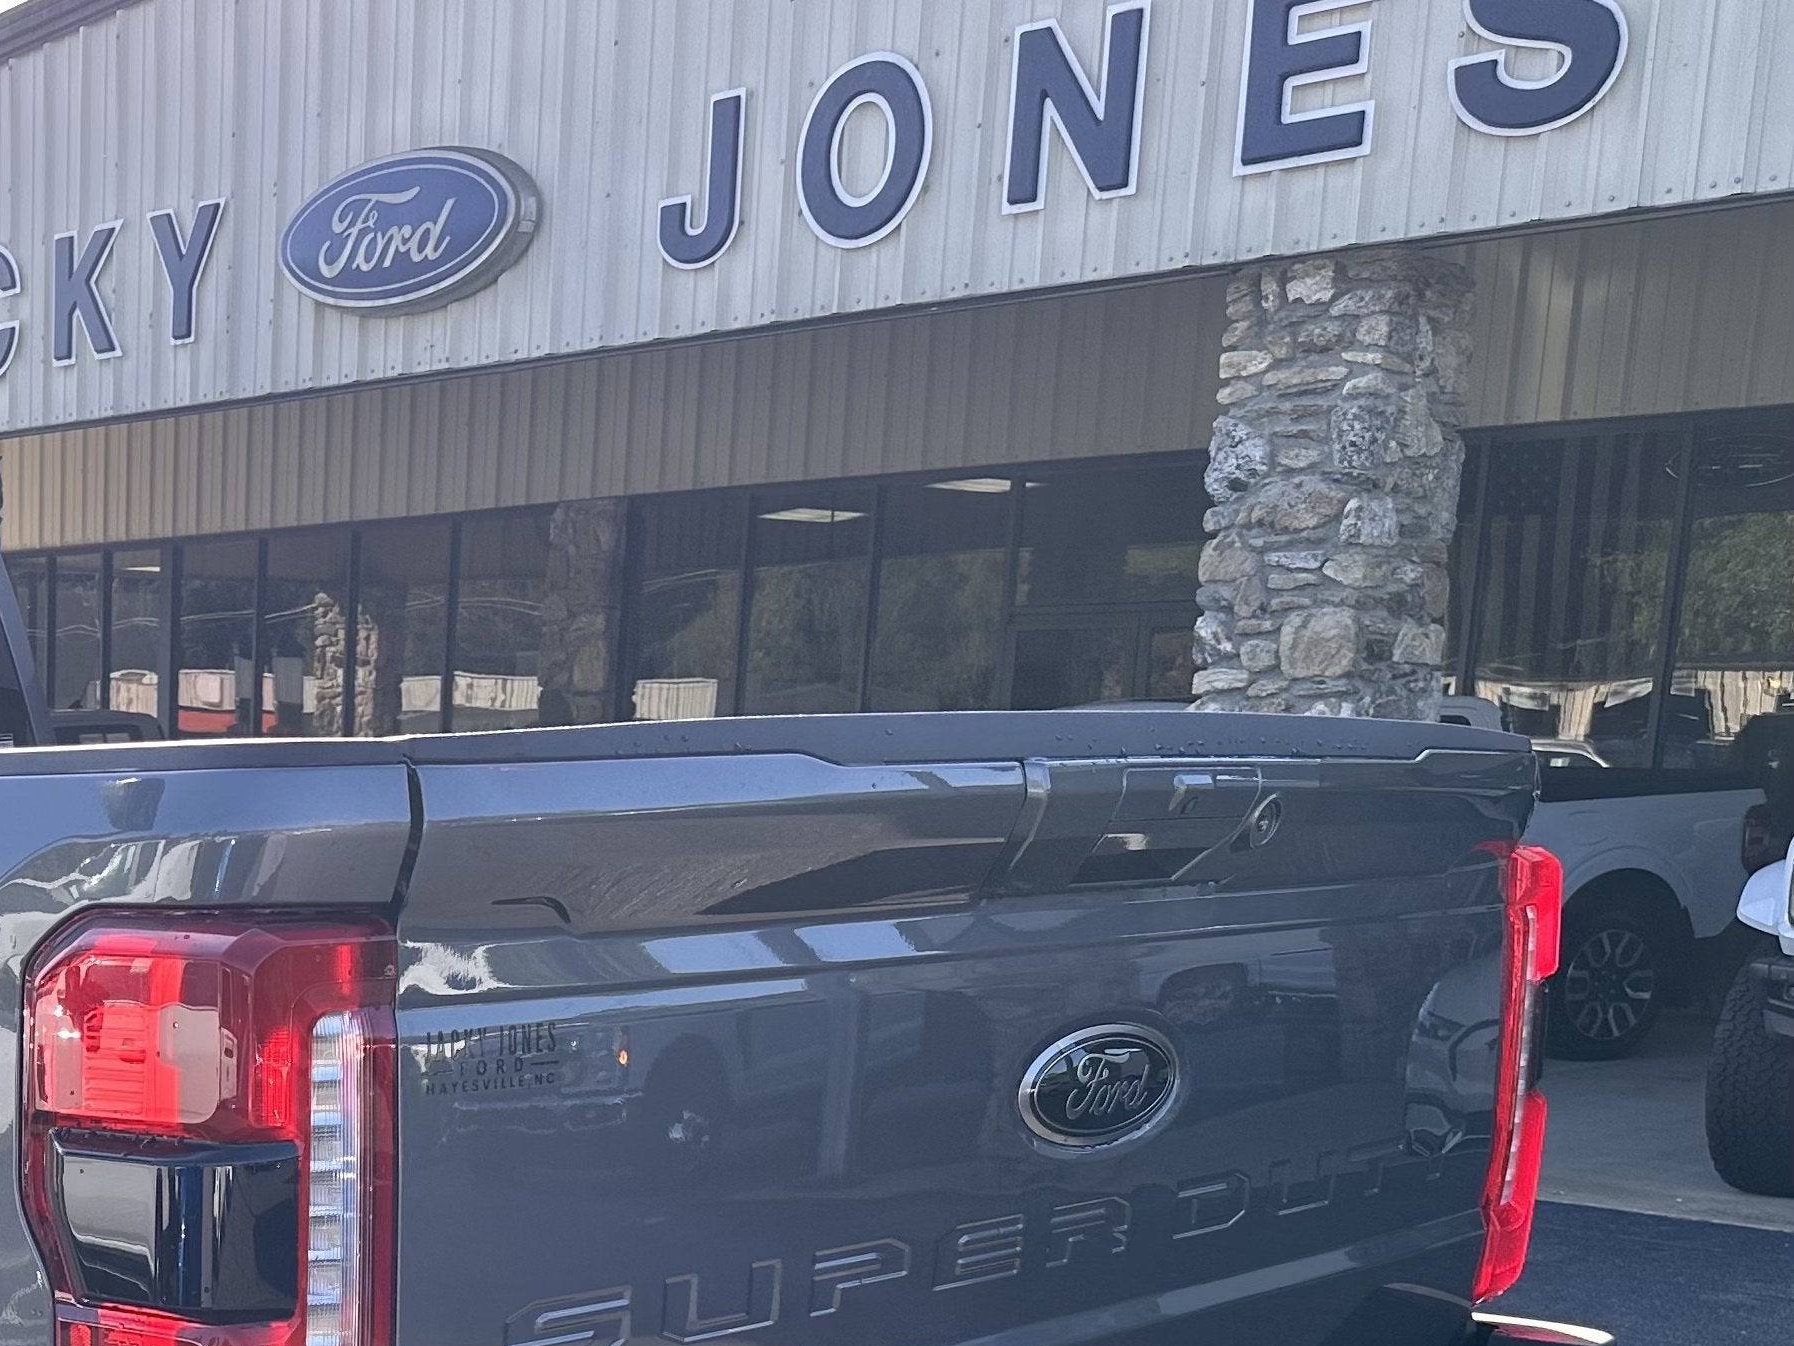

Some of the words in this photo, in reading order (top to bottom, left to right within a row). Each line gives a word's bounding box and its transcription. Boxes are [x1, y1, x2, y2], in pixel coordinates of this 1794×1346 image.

[657, 0, 1630, 271] JONES
[318, 184, 456, 281] Ford
[425, 1027, 487, 1062] JACKY
[499, 1021, 556, 1057] JONES
[459, 1057, 524, 1077] FORD
[1066, 1047, 1150, 1120] Ford
[1172, 1125, 1463, 1240] DUTY
